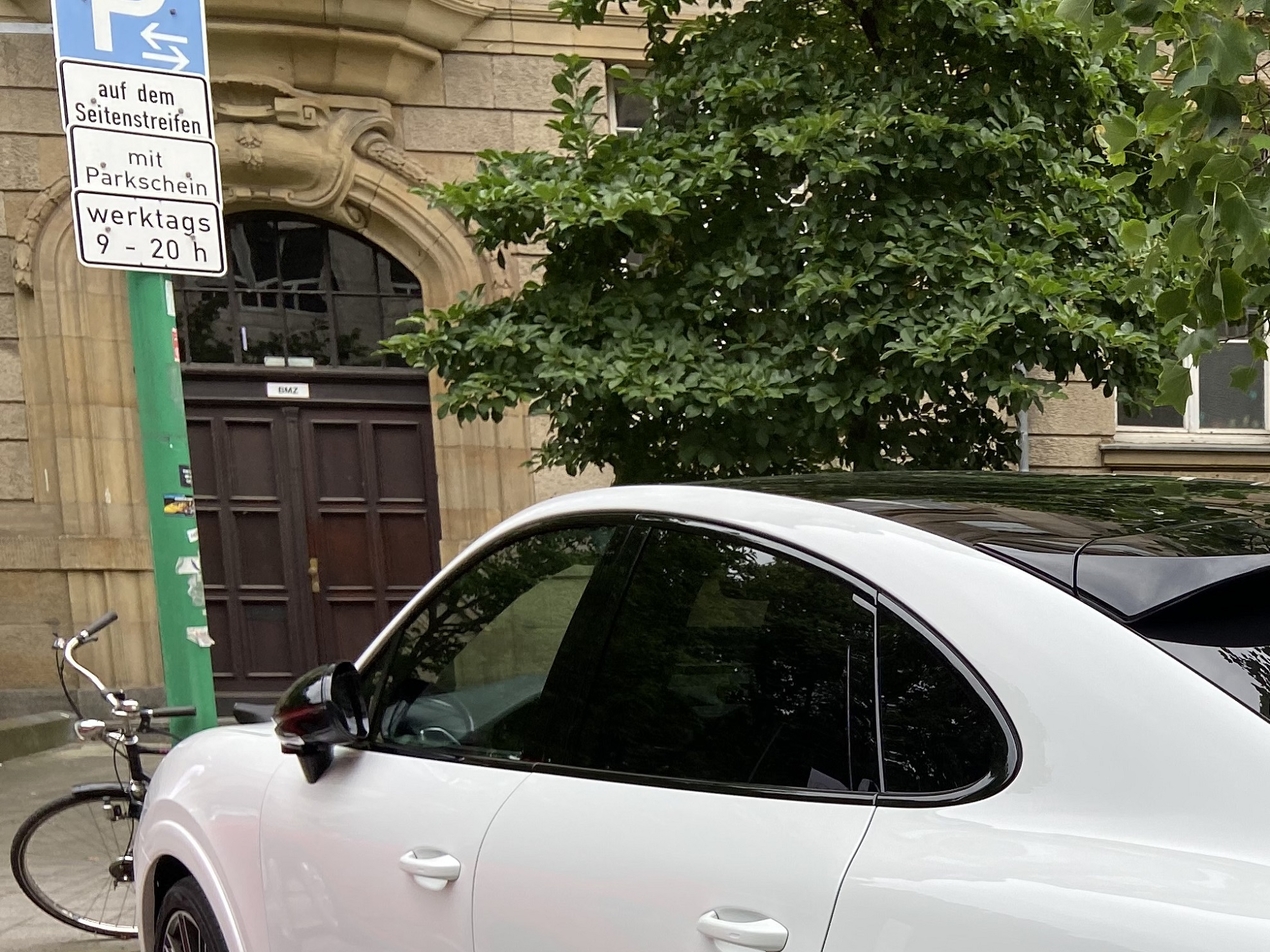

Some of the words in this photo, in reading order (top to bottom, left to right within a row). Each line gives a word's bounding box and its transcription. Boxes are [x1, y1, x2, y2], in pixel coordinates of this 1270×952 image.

[98, 81, 127, 100] auf
[137, 83, 175, 105] dem
[75, 102, 202, 135] Seitenstreifen
[128, 150, 163, 168] mit
[86, 166, 208, 197] Parkschein
[87, 206, 211, 236] werktags
[97, 234, 110, 255] 9
[151, 238, 180, 260] 20
[194, 242, 207, 263] h
